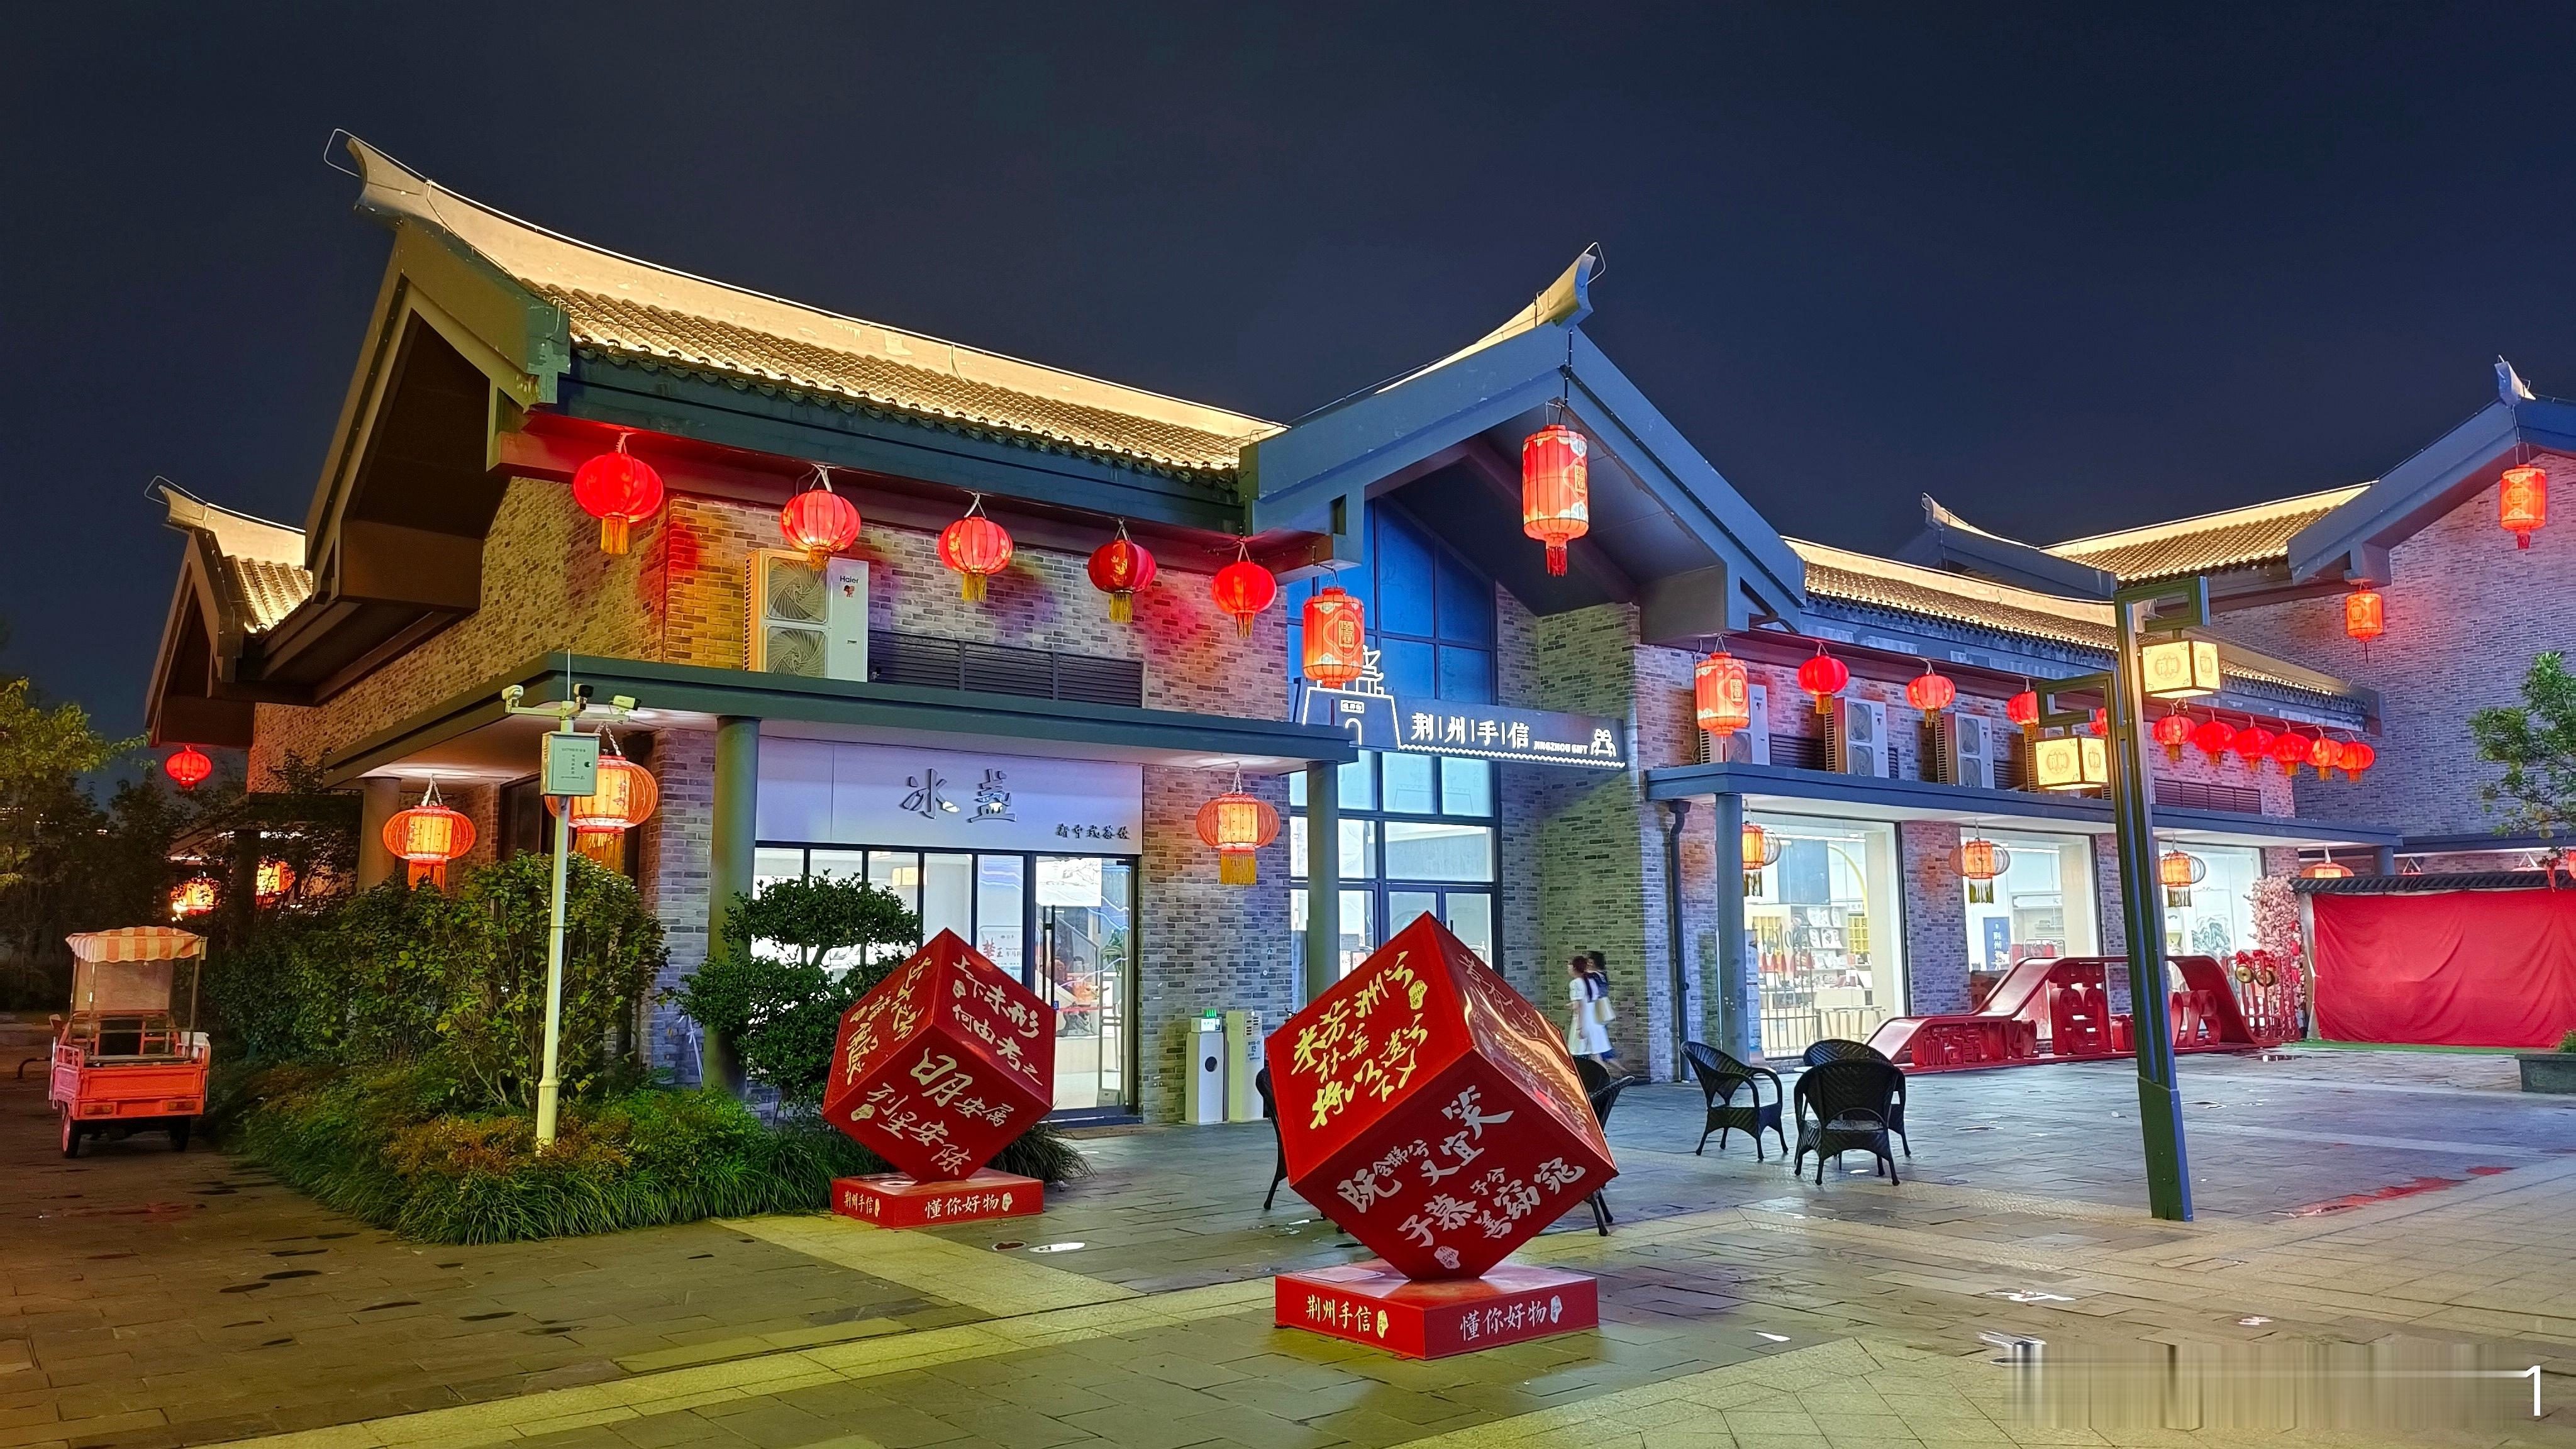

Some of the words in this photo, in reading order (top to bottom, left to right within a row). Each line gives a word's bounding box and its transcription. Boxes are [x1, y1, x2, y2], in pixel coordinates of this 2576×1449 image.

[840, 575, 859, 584] Haier
[1411, 711, 1531, 749] 荆州手信
[899, 768, 1018, 823] 冰盏
[953, 1003, 1043, 1087] 何由考之
[843, 1191, 874, 1214] 荆州手信
[924, 1194, 999, 1219] 懂你好物
[1306, 1295, 1372, 1333] 荆州手信
[1460, 1300, 1547, 1341] 懂你好物
